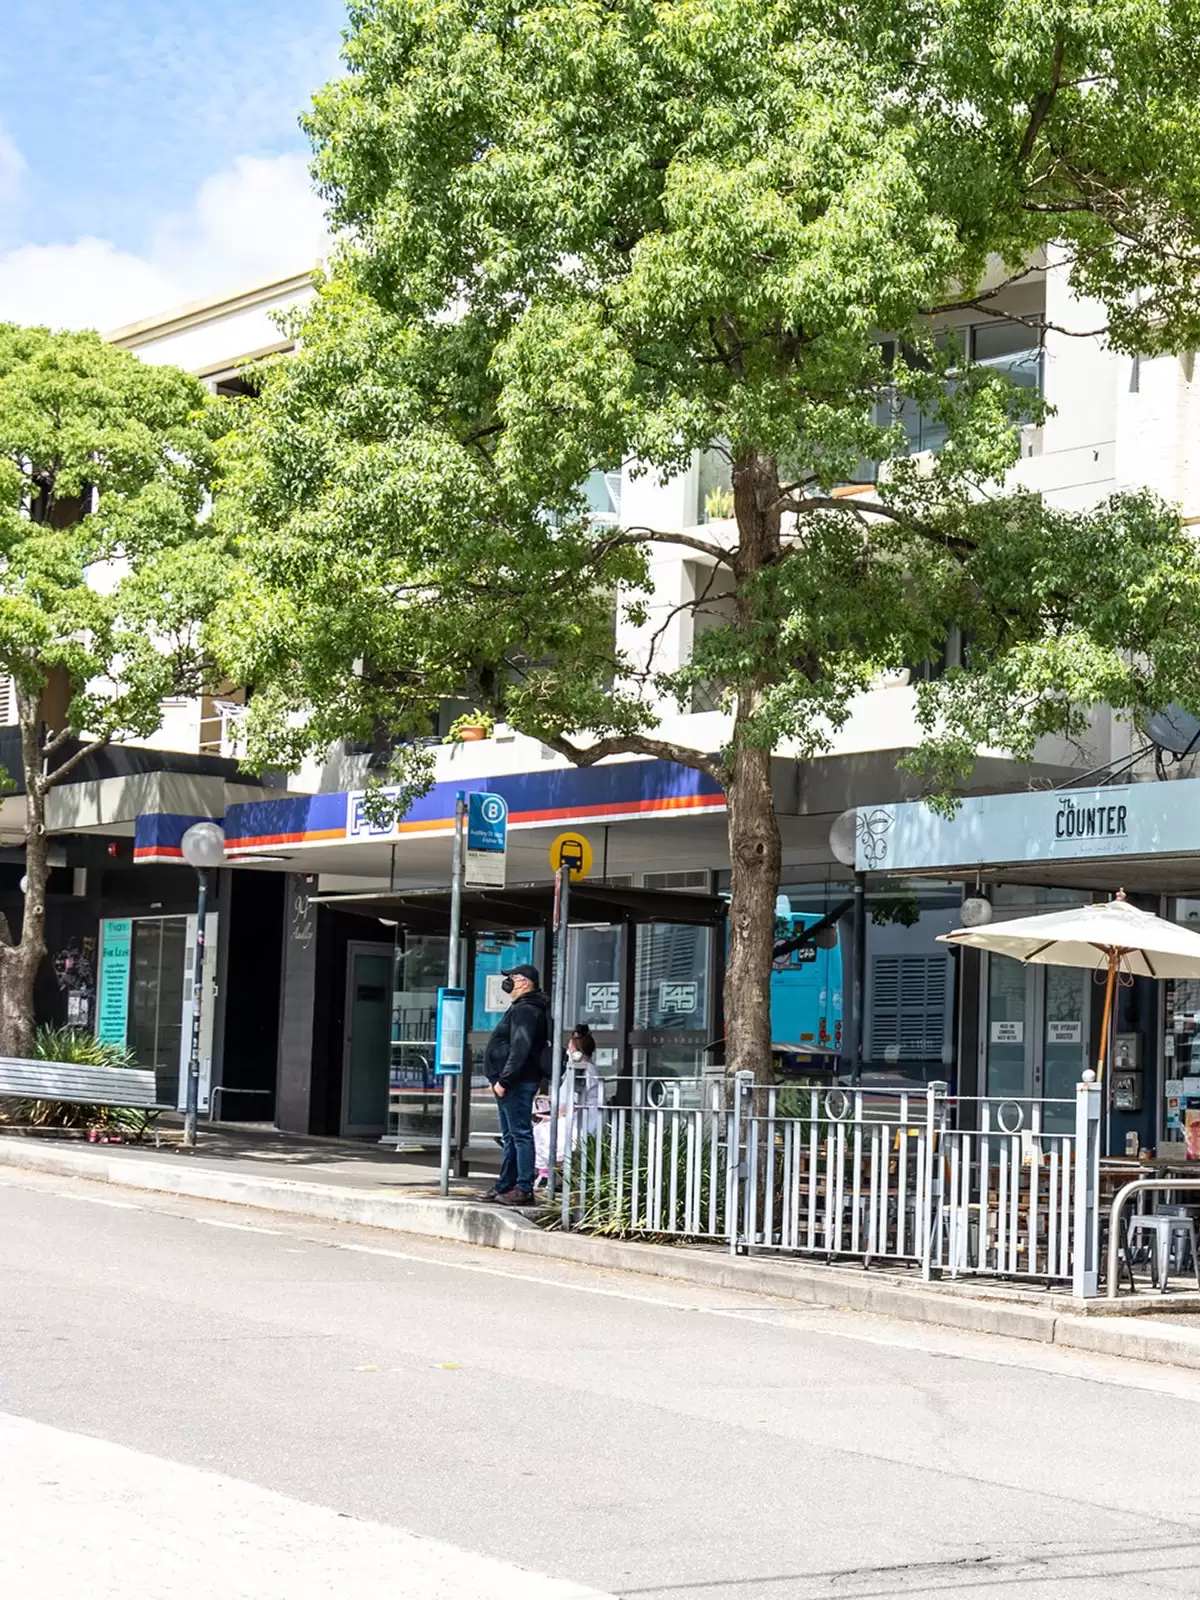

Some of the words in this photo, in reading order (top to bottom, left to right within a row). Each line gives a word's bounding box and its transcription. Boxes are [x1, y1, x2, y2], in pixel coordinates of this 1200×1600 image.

[1058, 797, 1075, 812] The
[1056, 805, 1127, 838] COUNTER
[585, 982, 619, 1013] F45
[659, 981, 698, 1014] F45
